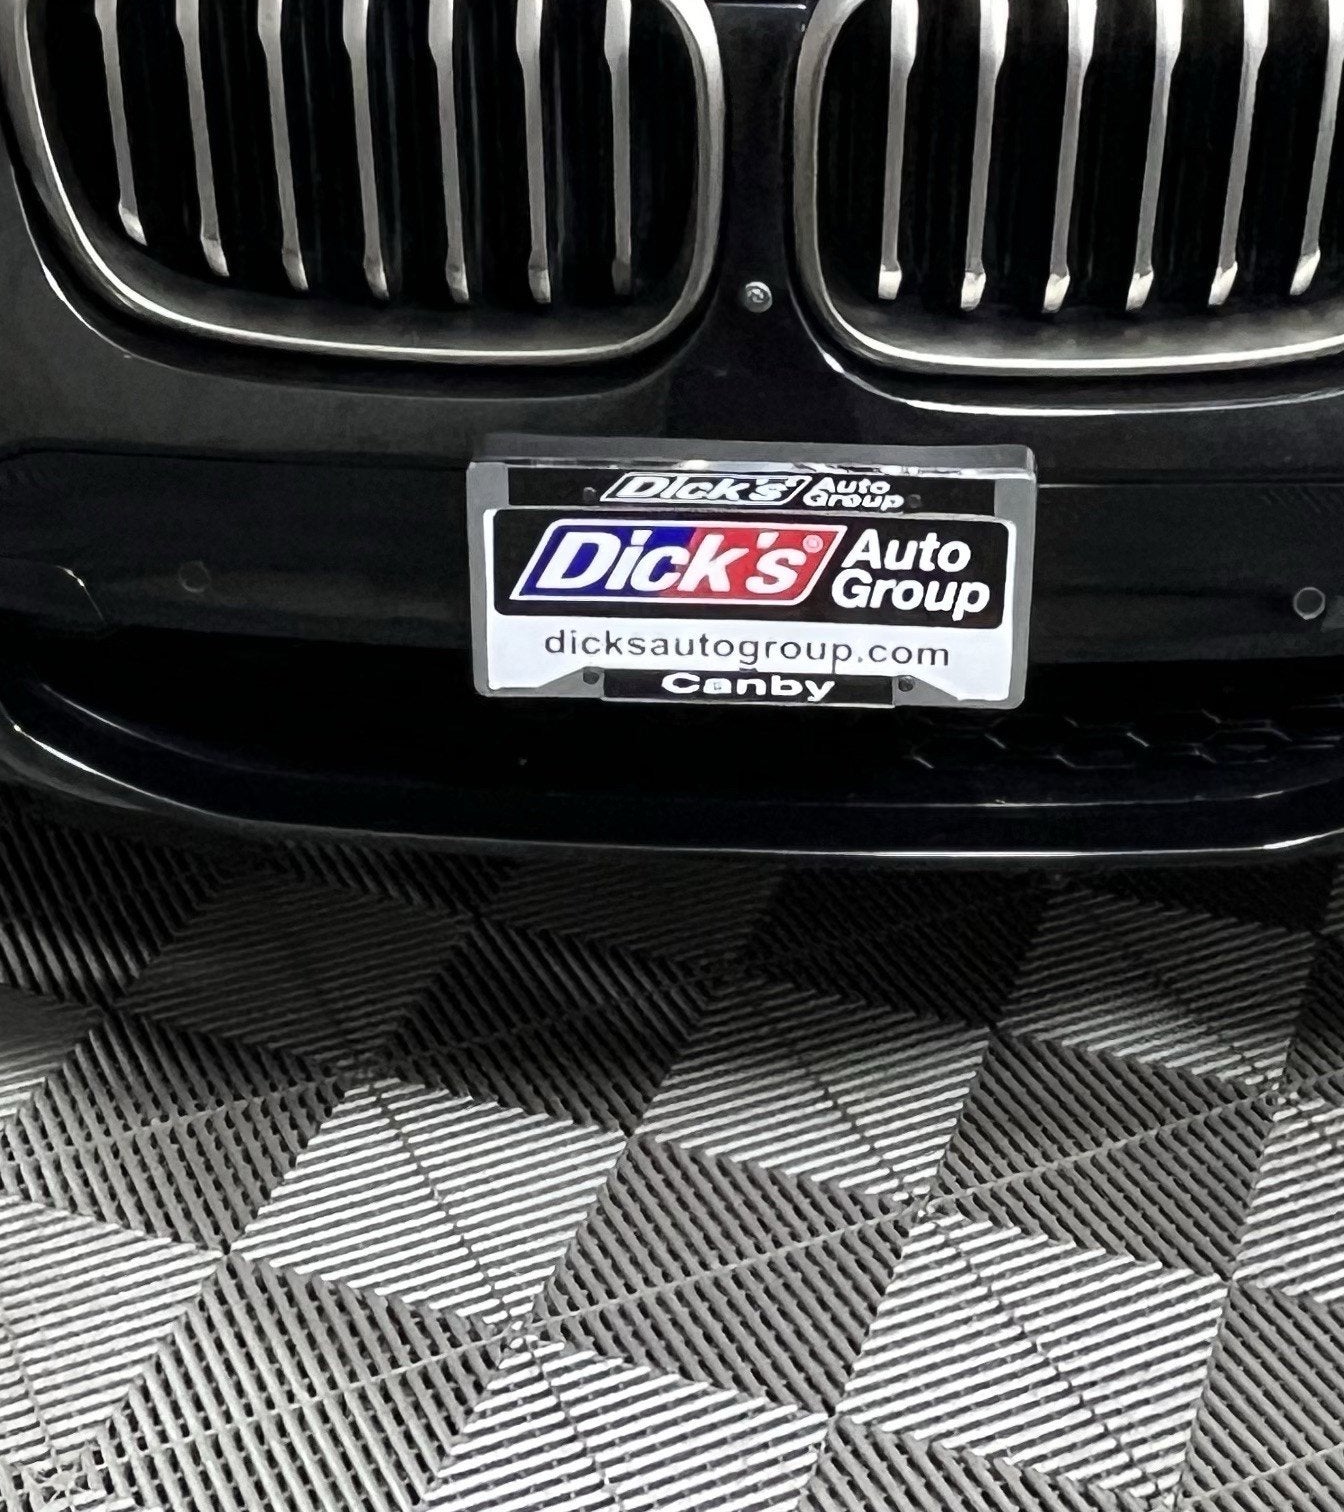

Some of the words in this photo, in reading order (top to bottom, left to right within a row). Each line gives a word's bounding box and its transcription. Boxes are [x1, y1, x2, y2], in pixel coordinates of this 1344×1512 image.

[801, 489, 905, 512] Group
[810, 476, 891, 495] Auto
[840, 528, 972, 573] Auto
[831, 568, 991, 623] Group
[544, 629, 950, 675] dicksautogroup.com
[660, 671, 837, 703] Canby
